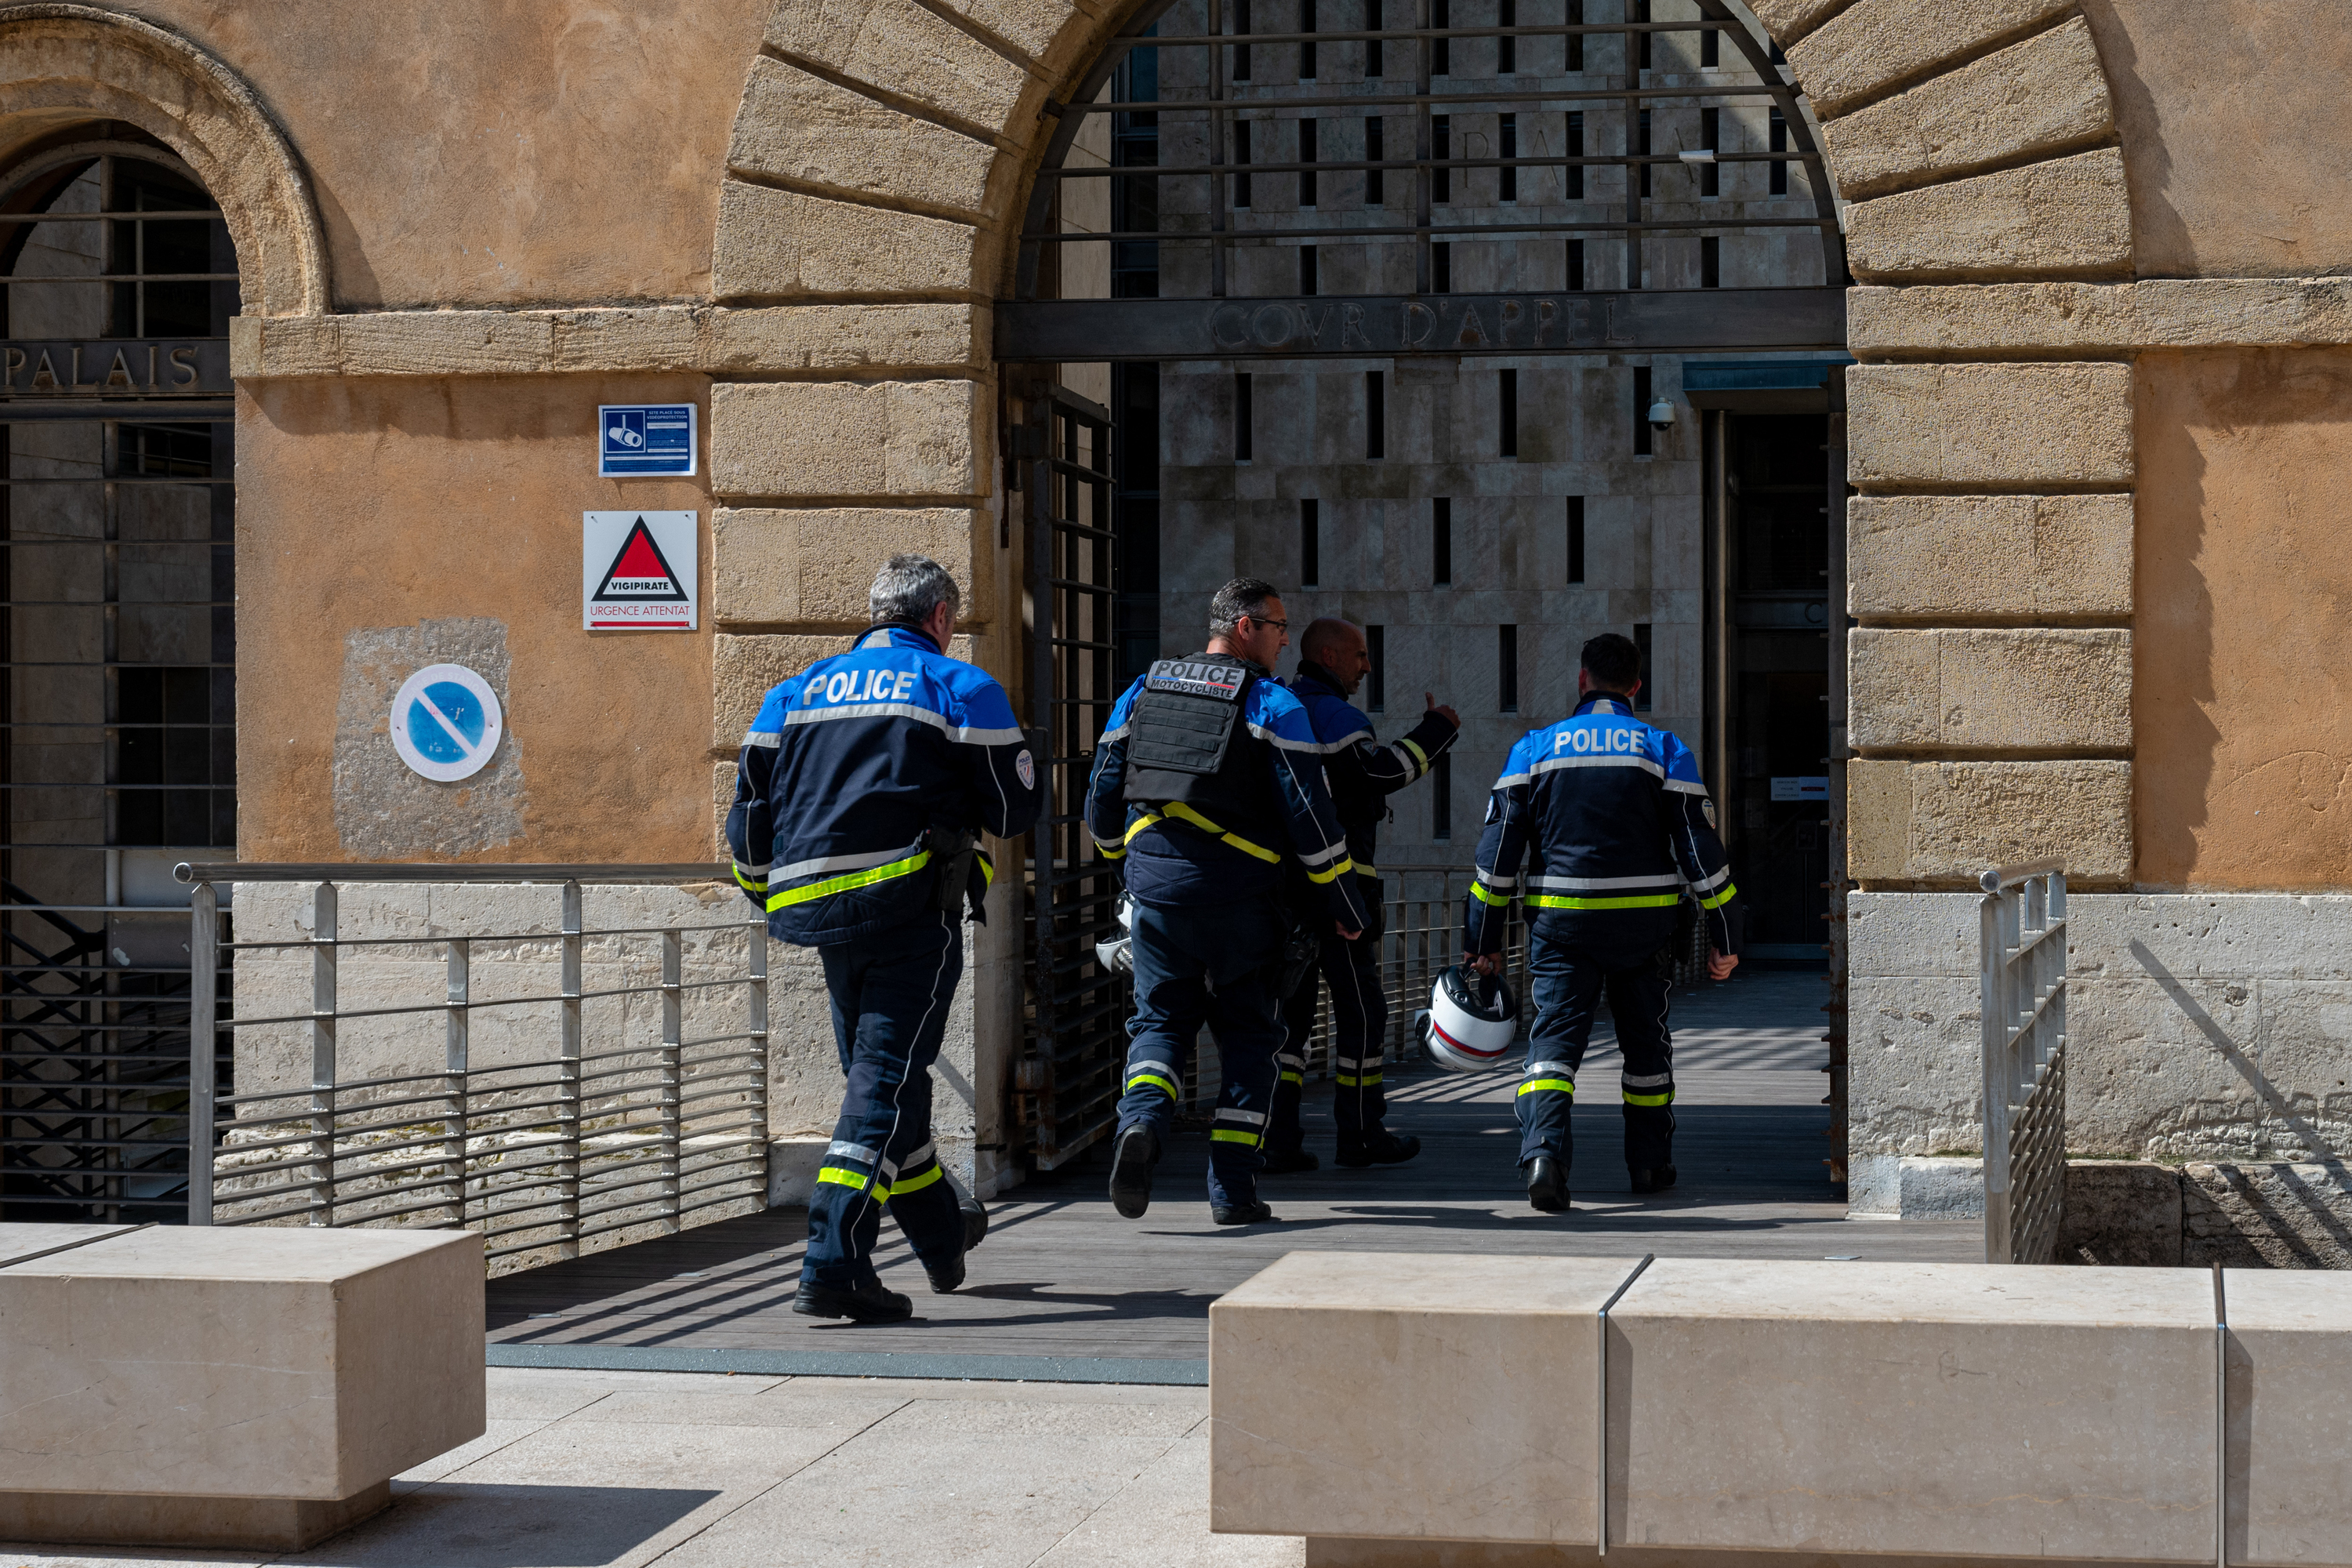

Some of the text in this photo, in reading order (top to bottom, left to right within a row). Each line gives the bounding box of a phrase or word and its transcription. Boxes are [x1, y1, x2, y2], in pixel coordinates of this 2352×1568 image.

[1401, 298, 1635, 346] D'APPEL
[2, 346, 198, 387] PALAIS
[590, 606, 690, 615] URGENCE ATTENTAT
[803, 670, 917, 705] POLICE
[1151, 679, 1233, 698] MOTOCYCLISTE
[1154, 661, 1240, 686] POLICE
[430, 672, 444, 681] DE
[448, 671, 494, 717] STATIONNER
[1554, 728, 1645, 755] POLICE
[403, 743, 430, 771] SORTIE
[451, 746, 488, 775] SECOURS
